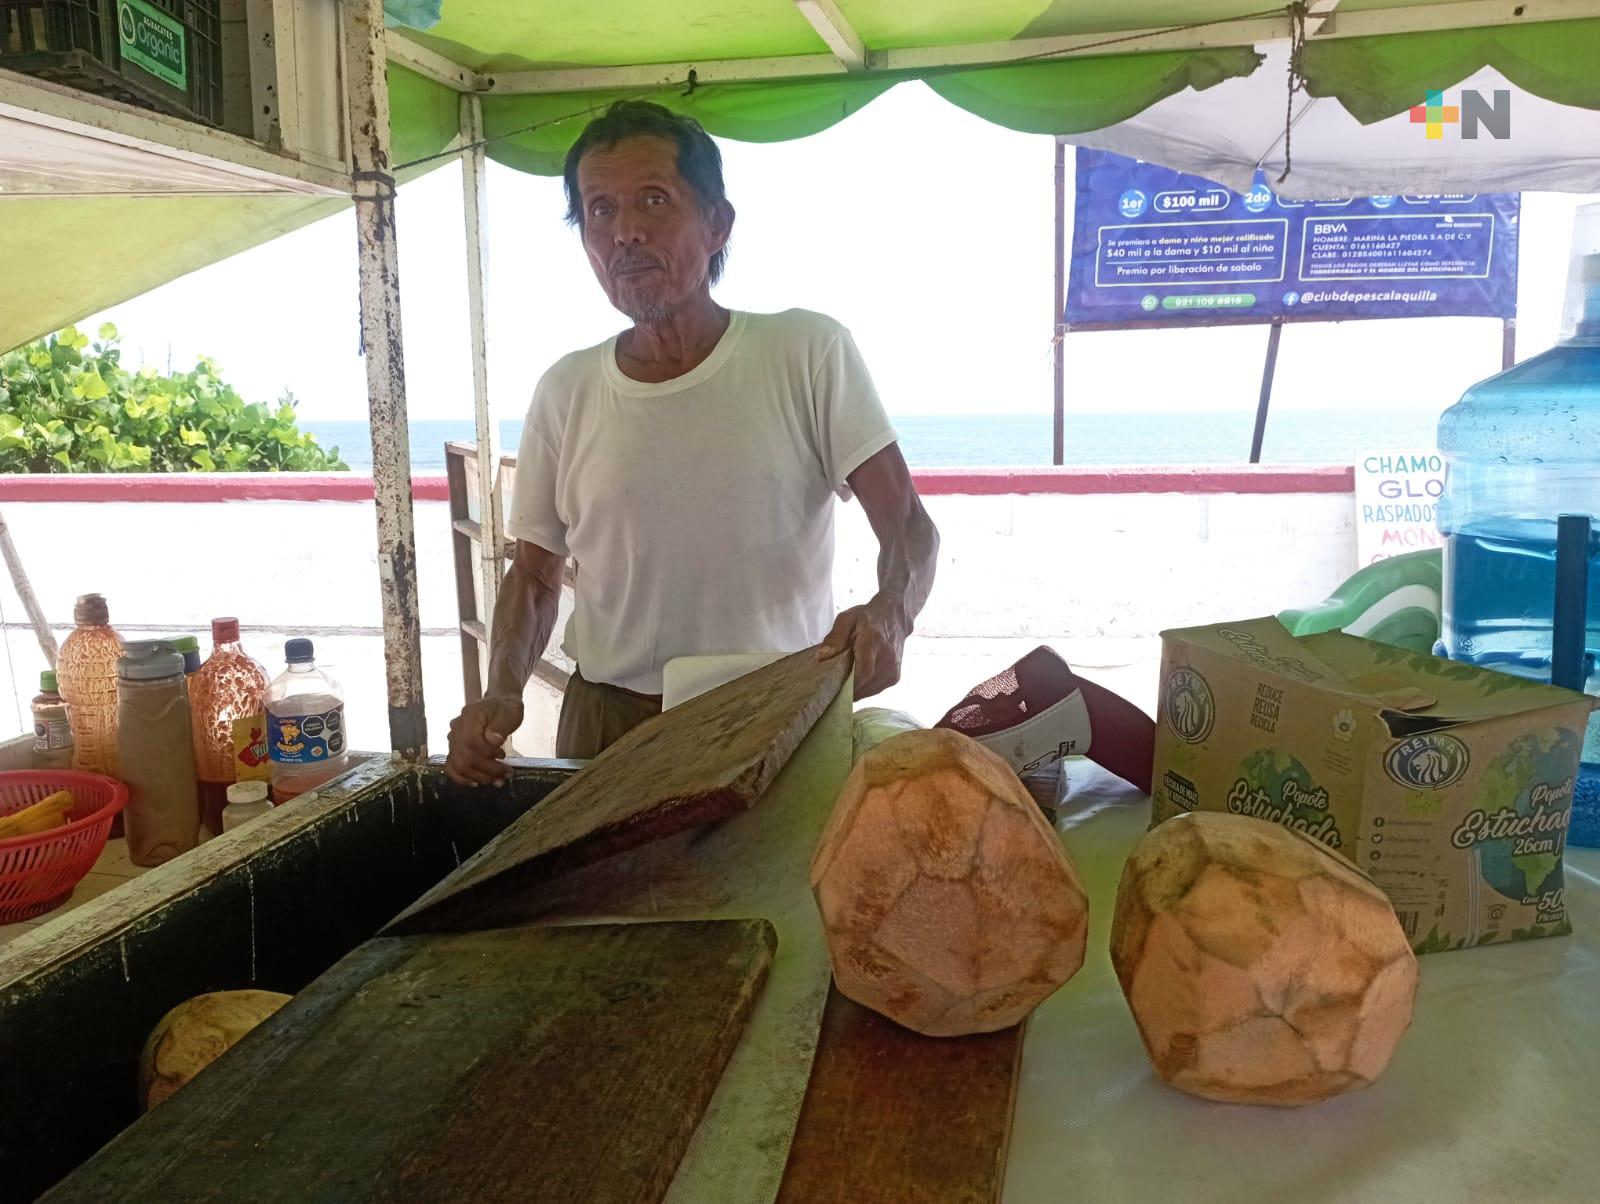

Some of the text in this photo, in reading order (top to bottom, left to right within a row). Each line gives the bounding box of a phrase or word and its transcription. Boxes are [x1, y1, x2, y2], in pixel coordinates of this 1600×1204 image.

[1121, 198, 1144, 210] 1er
[1163, 194, 1220, 208] $100 mil
[1245, 193, 1271, 204] 2do
[1314, 223, 1348, 234] BBVA
[1158, 237, 1182, 245] dama
[1210, 235, 1234, 243] mejor
[1235, 233, 1275, 241] calificado
[1353, 234, 1386, 242] MARINA
[1399, 233, 1428, 241] PIEDRA
[1106, 248, 1125, 258] $40
[1127, 247, 1142, 257] mil
[1153, 247, 1162, 256] la
[1164, 246, 1192, 256] dama
[1193, 248, 1200, 257] y
[1202, 245, 1221, 254] $10
[1223, 243, 1238, 253] mil
[1240, 243, 1250, 253] al
[1252, 243, 1274, 253] niño
[1117, 261, 1262, 276] Premio por liberación de sabalo
[1301, 290, 1437, 304] @clubdepescalaquilla
[1256, 682, 1285, 704] REDUCE
[1253, 696, 1280, 722] REUSA
[1399, 735, 1456, 756] REYMA
[1282, 780, 1328, 809] Popote
[1514, 837, 1553, 856] 26cm
